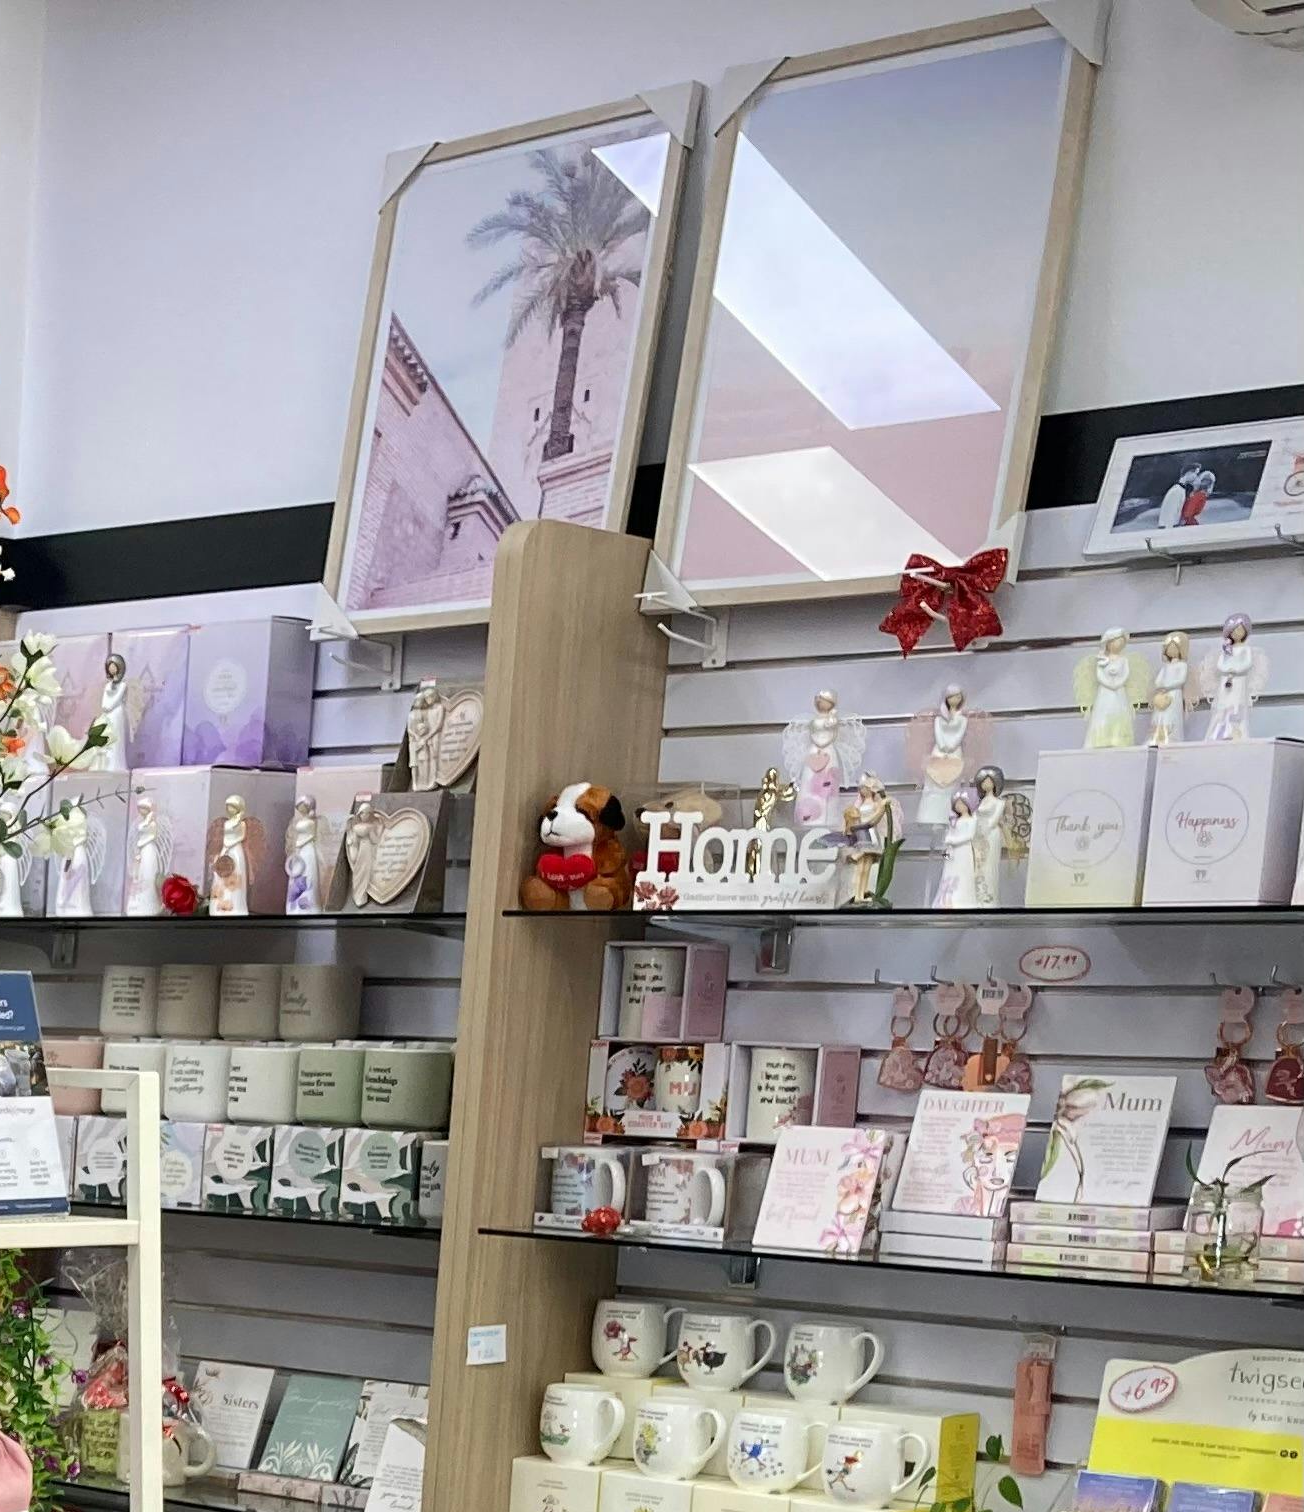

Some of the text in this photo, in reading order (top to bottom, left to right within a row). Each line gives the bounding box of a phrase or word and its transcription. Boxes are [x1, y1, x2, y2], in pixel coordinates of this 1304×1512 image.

[1047, 814, 1122, 837] Thank you
[1174, 811, 1241, 830] Happiness
[640, 809, 839, 884] Home
[924, 1097, 1005, 1113] DAUGHTER
[1102, 1092, 1162, 1111] Mum
[786, 1149, 831, 1166] MUM
[223, 1393, 259, 1409] Sisters
